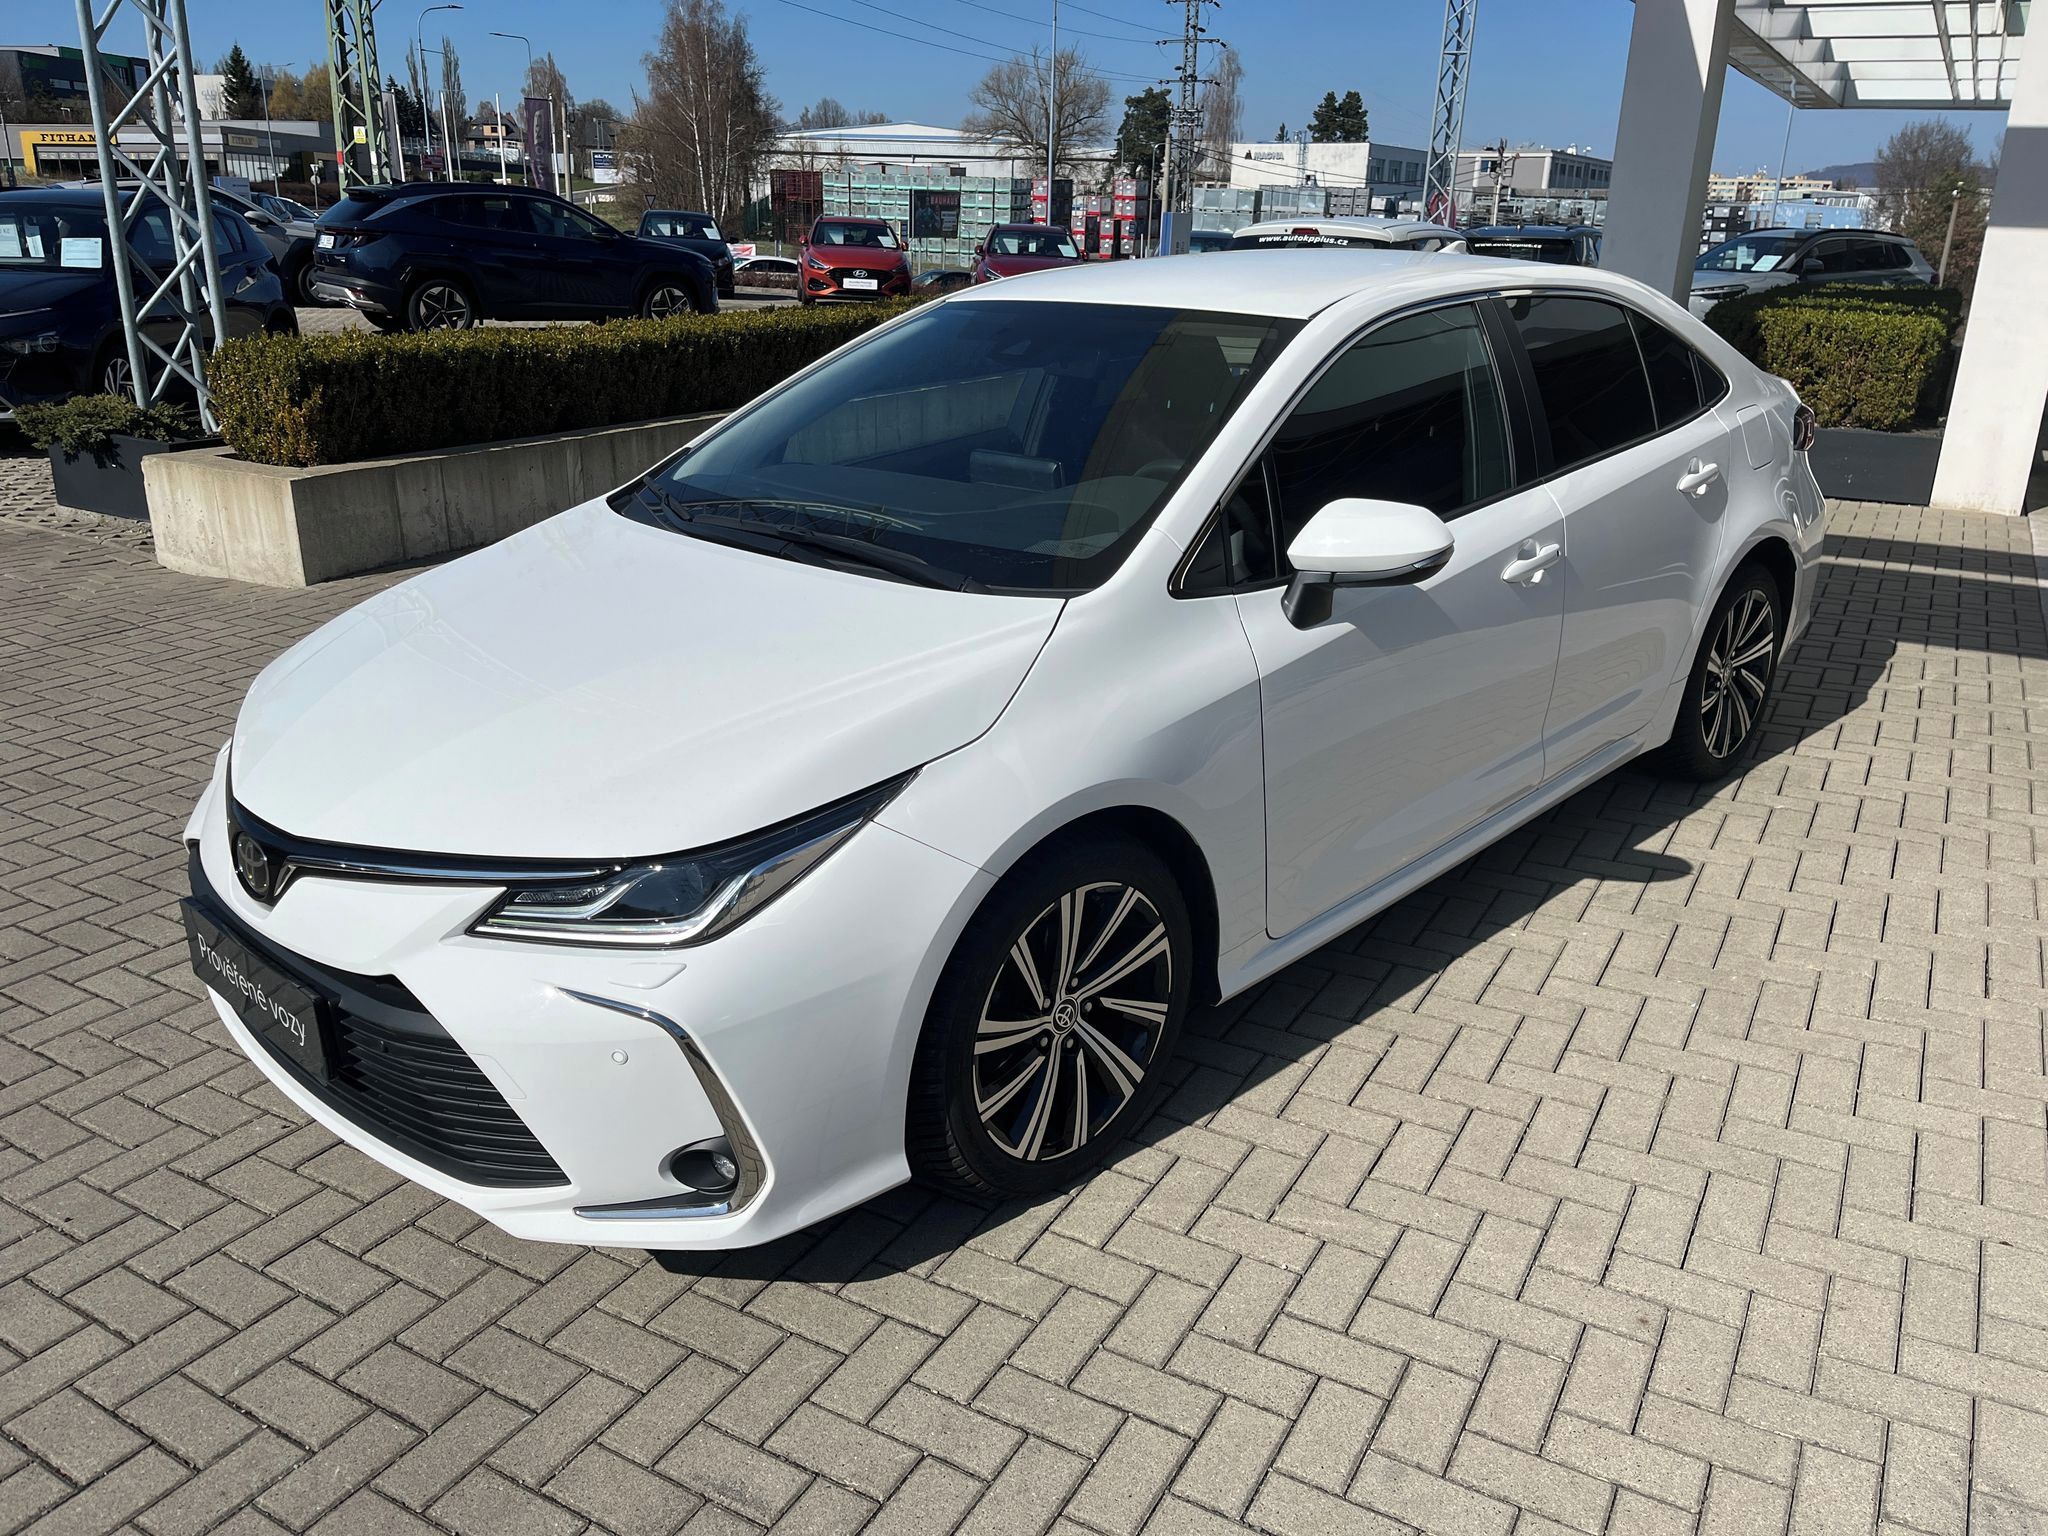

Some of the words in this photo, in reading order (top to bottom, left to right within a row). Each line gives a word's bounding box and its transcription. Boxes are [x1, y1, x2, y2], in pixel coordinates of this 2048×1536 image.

[1258, 234, 1349, 246] www.autokpplus.cz
[197, 932, 268, 1011] Prověřené
[268, 997, 305, 1047] vozy
